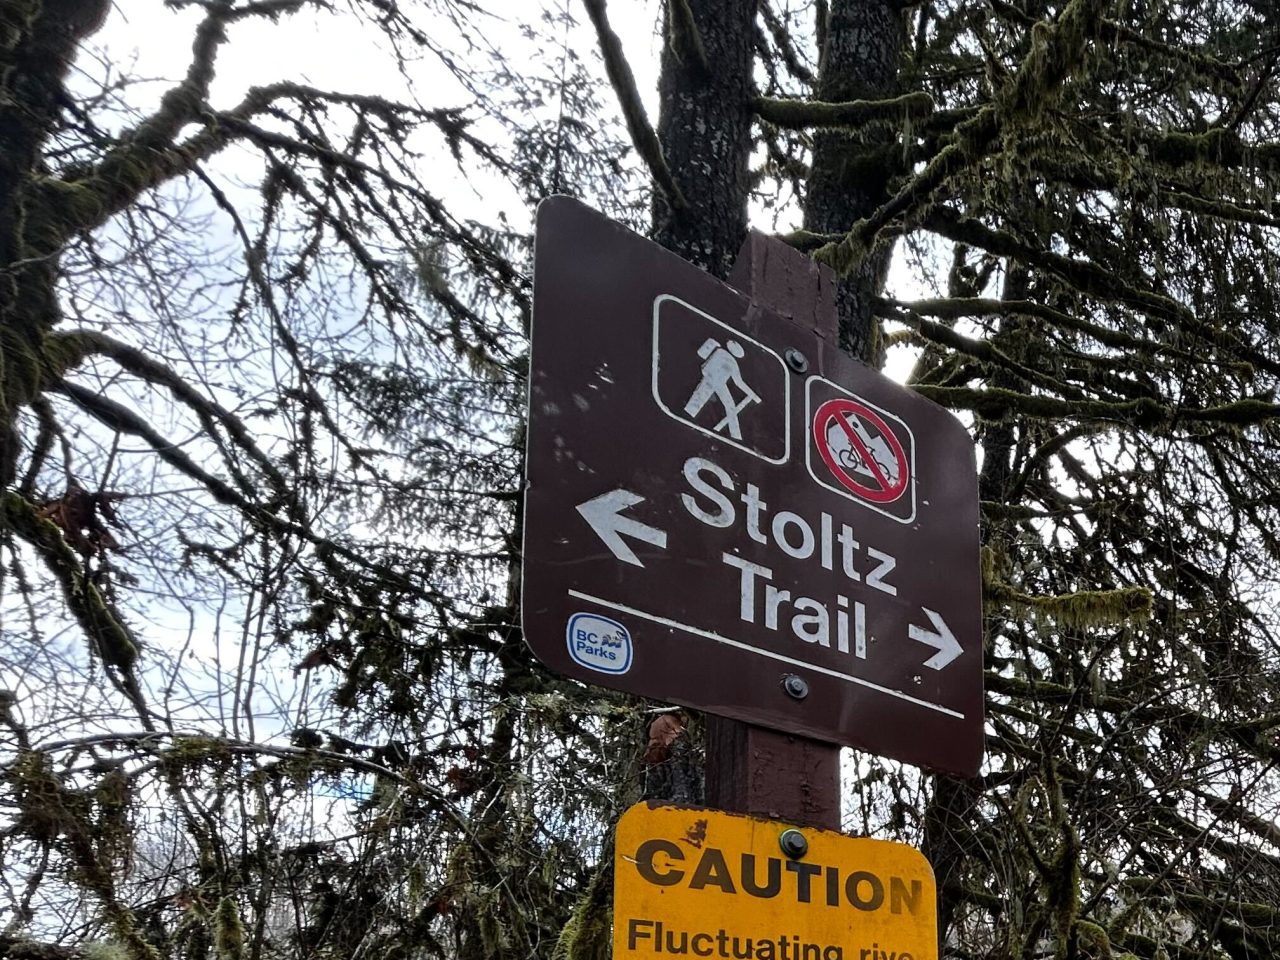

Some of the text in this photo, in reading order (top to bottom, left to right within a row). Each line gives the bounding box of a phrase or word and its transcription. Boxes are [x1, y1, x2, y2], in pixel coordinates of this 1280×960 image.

[681, 457, 897, 597] Stoltz
[576, 629, 598, 644] BC
[722, 552, 867, 660] Trail
[576, 641, 617, 661] Parks
[634, 839, 922, 916] CAUTION
